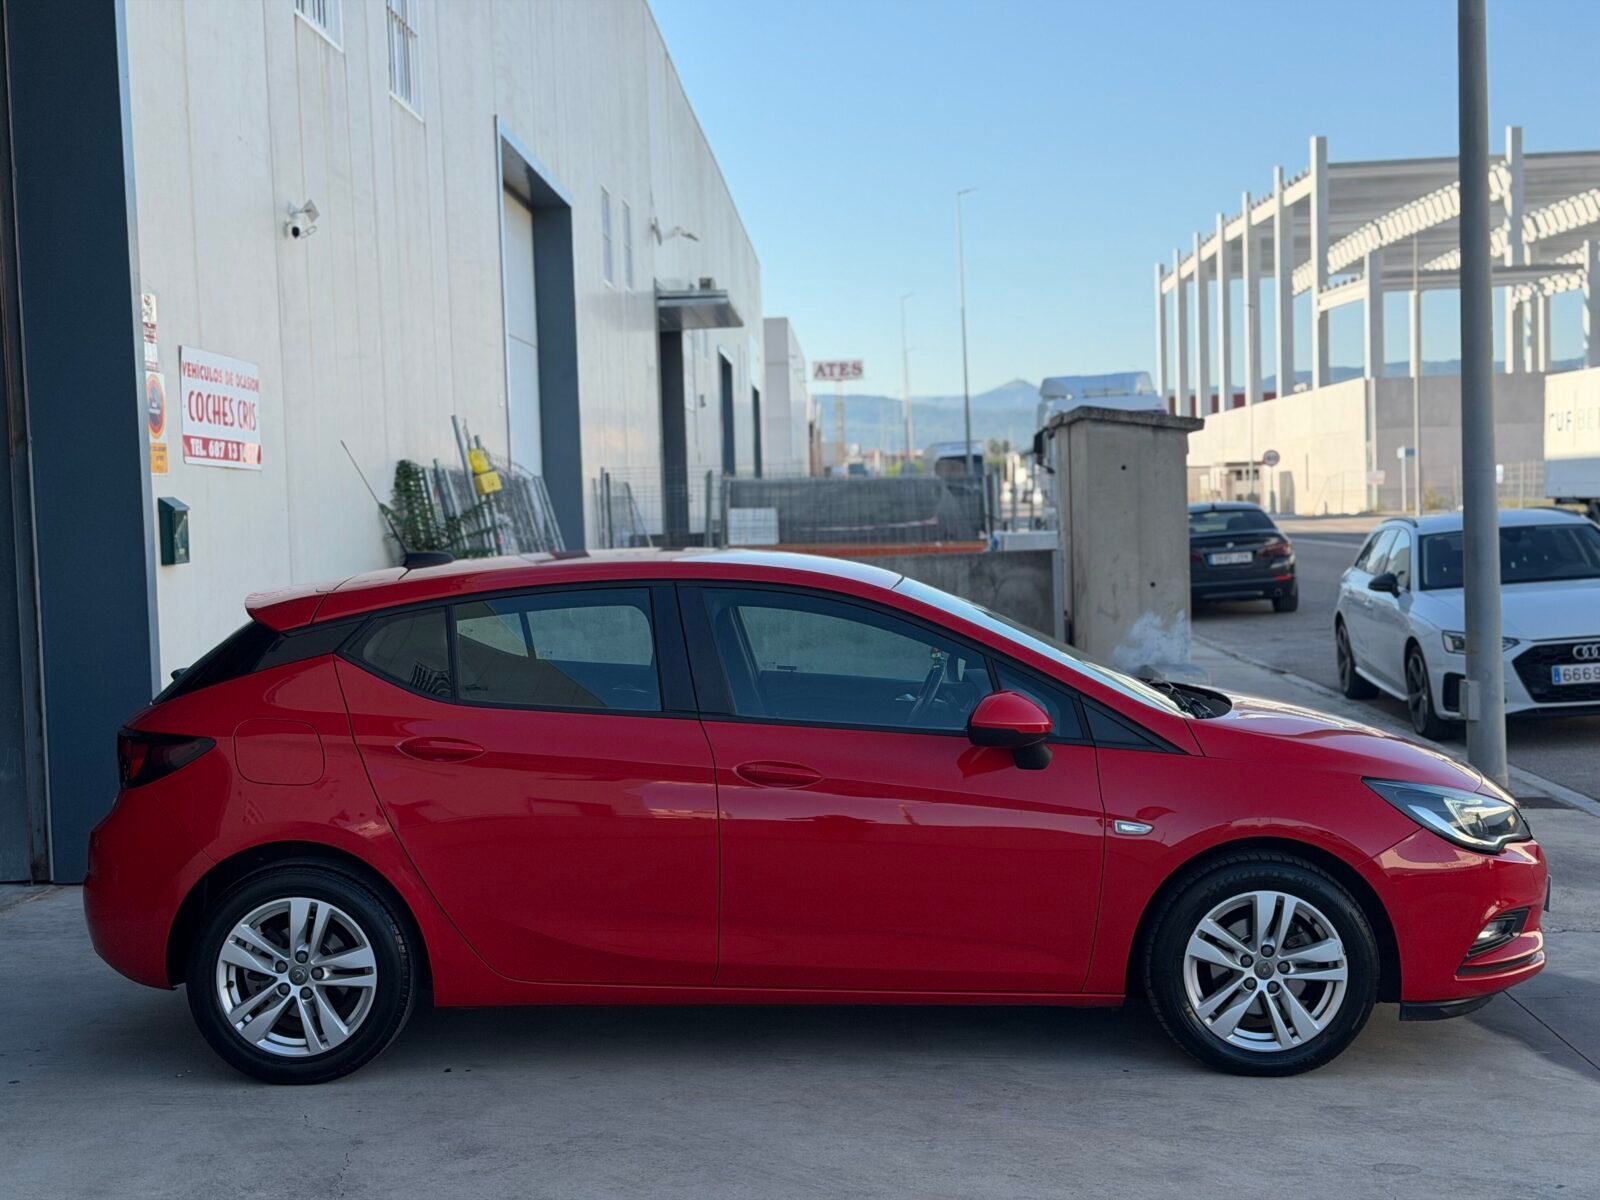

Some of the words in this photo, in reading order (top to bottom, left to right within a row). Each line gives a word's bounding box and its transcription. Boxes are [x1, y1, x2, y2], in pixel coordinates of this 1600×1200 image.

[814, 361, 863, 377] ATES
[225, 370, 233, 386] DE
[188, 390, 235, 427] COCHES
[237, 399, 257, 431] CRIS
